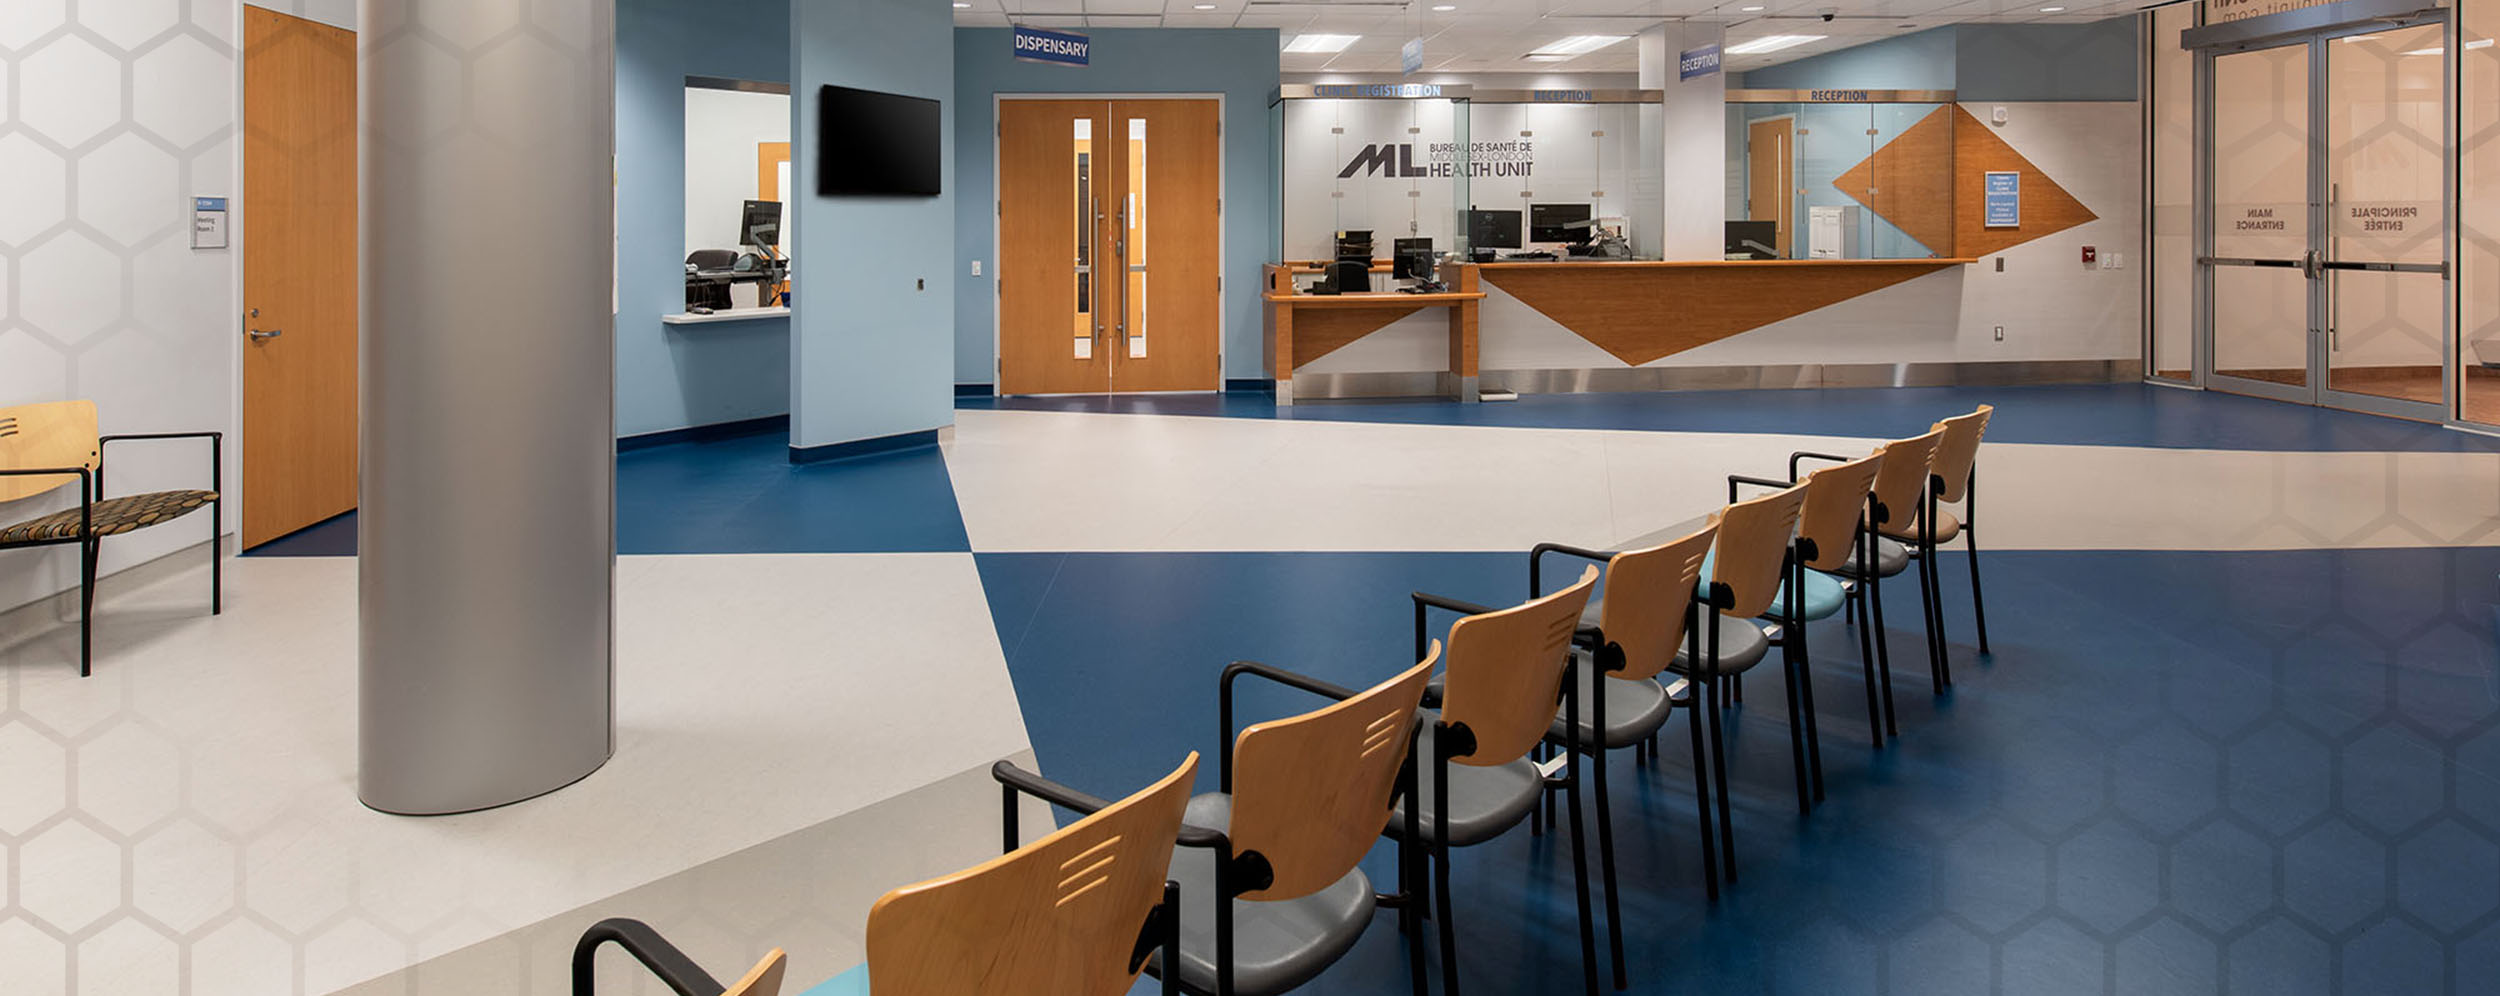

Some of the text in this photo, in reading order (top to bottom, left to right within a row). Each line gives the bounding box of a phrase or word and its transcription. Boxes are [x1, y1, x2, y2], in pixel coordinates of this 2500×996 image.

[1016, 34, 1088, 57] DISPENSARY
[1681, 53, 1719, 71] RECEPTION
[1314, 85, 1441, 96] CLINIC REGISTRATION
[1535, 89, 1592, 101] RECEPTION
[1811, 90, 1868, 101] RECEPTION
[1430, 140, 1533, 153] BUREAU DE SANTÉ DE
[1337, 144, 1427, 178] ML
[1430, 161, 1533, 177] HEALTH UNIT
